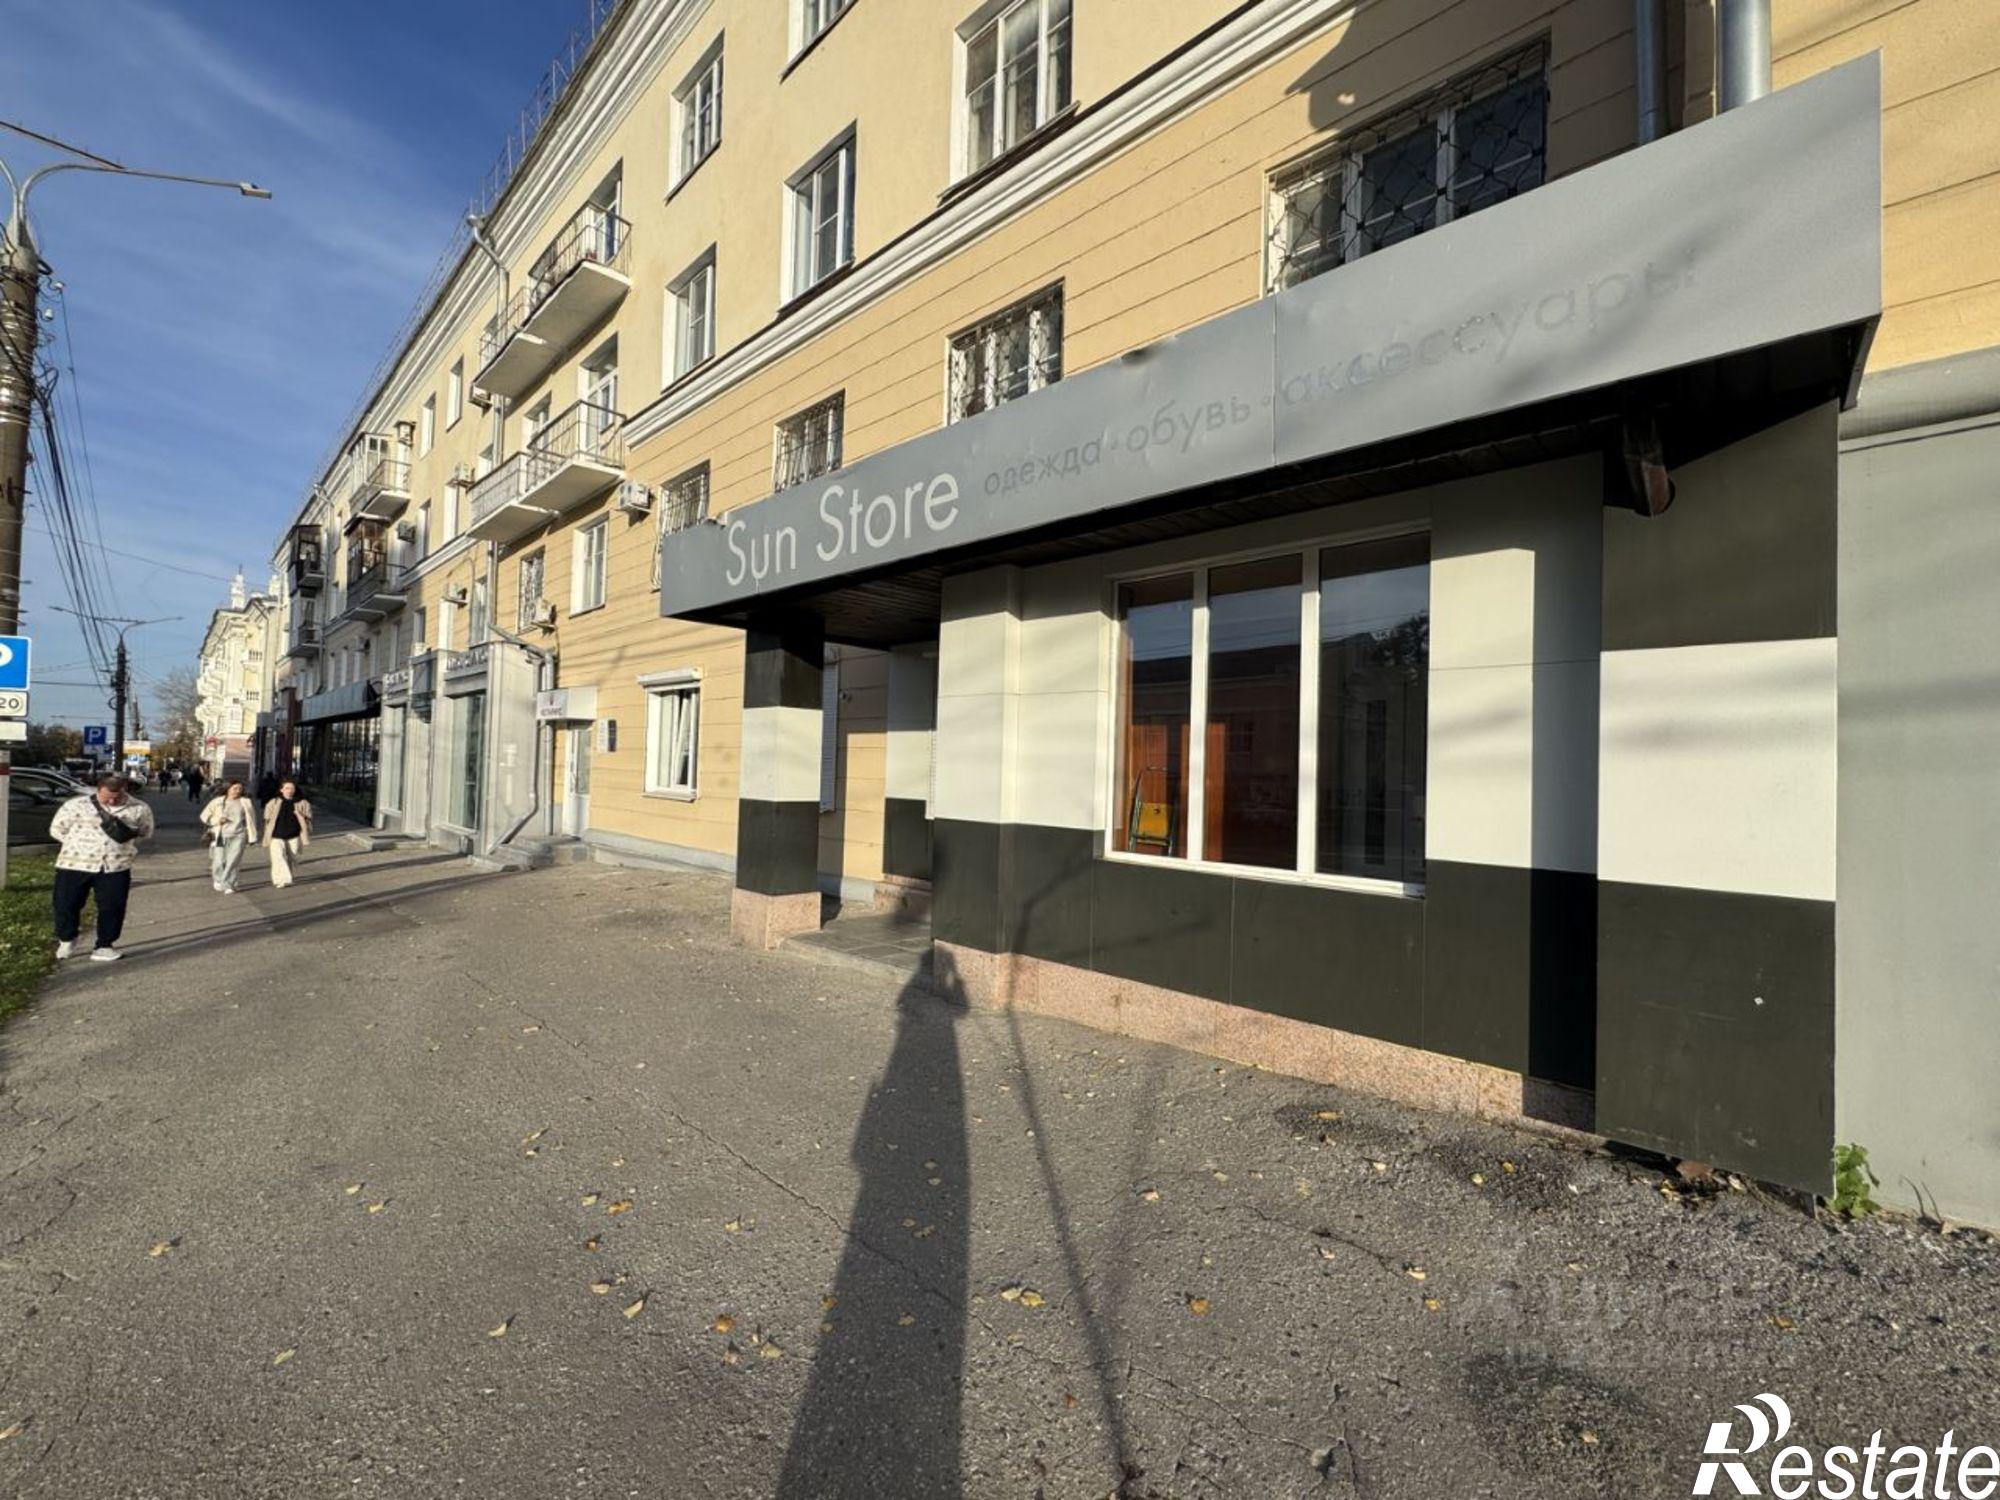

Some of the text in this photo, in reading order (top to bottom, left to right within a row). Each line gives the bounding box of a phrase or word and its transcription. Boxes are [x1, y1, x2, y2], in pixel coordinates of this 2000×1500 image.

[984, 430, 1104, 496] одежда
[1126, 397, 1251, 453] обувь
[726, 473, 960, 586] Sun Store
[88, 728, 102, 743] P
